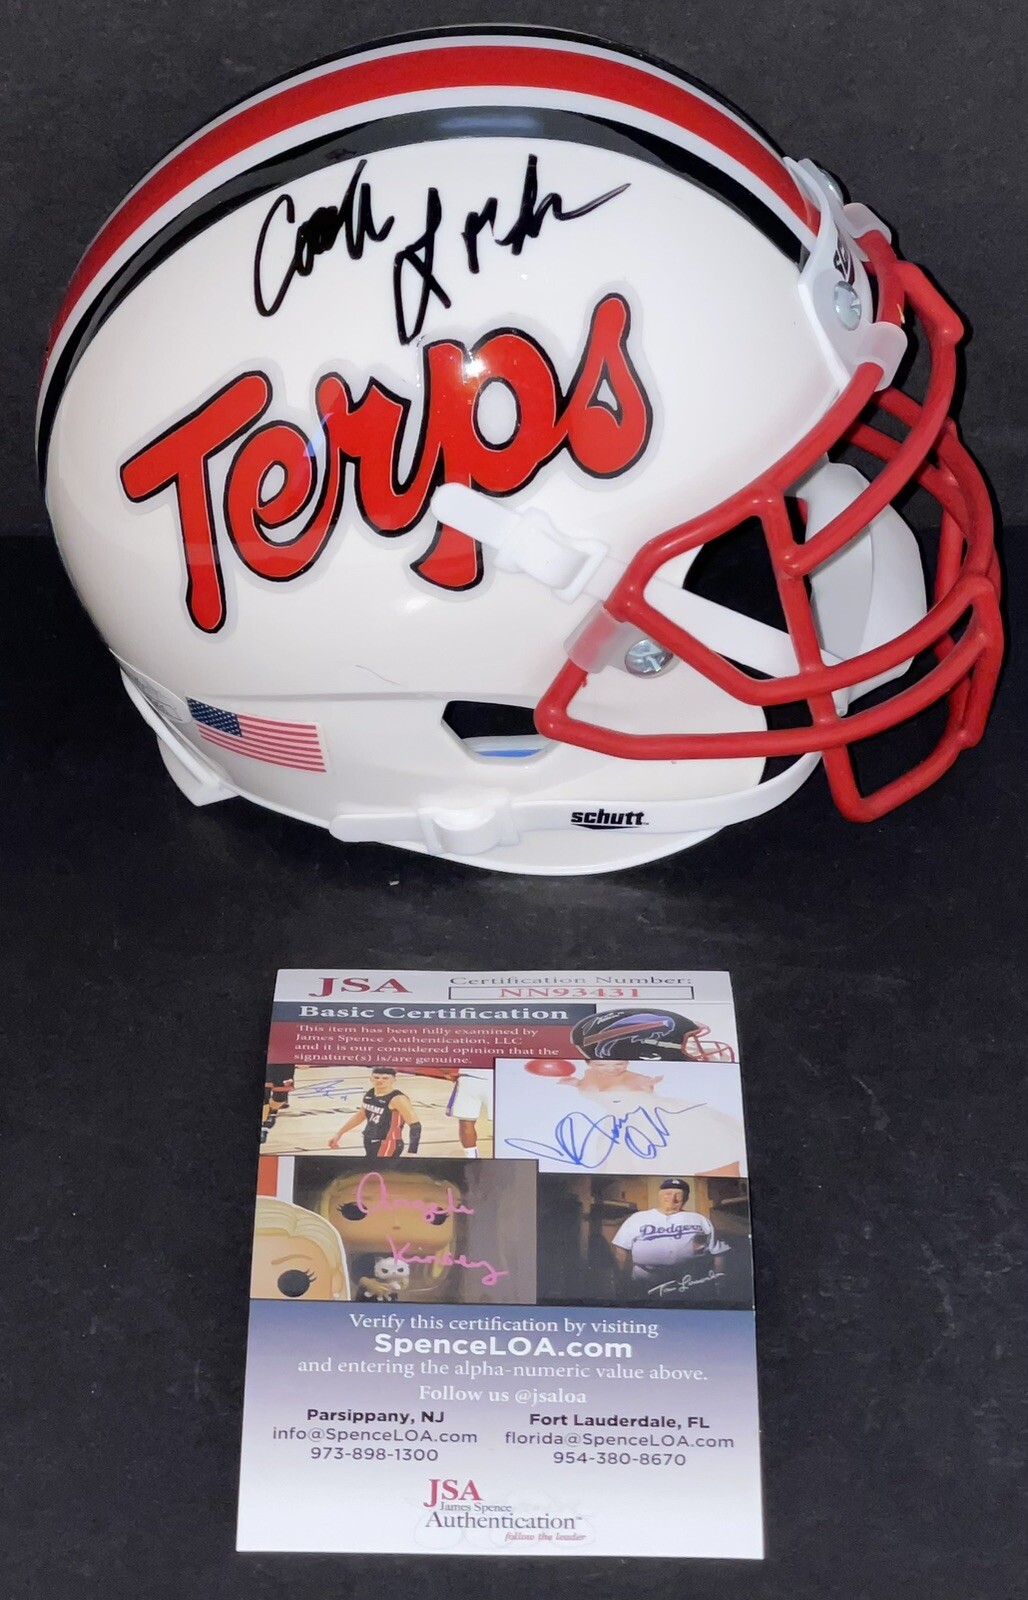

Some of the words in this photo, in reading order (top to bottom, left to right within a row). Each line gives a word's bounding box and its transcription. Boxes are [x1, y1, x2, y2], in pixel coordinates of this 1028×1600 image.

[119, 292, 654, 634] Terps
[571, 809, 644, 825] schutt
[309, 977, 412, 997] JSA
[500, 988, 640, 998] NN93431
[298, 1005, 375, 1018] Basic
[383, 1006, 569, 1020] Certification
[298, 1025, 324, 1033] This
[361, 1026, 383, 1034] has
[386, 1026, 418, 1034] been
[422, 1026, 451, 1036] fully
[454, 1027, 520, 1035] examined
[522, 1028, 539, 1037] by
[295, 1034, 334, 1042] James
[338, 1034, 385, 1044] Spence
[388, 1035, 491, 1045] Authentication,
[494, 1037, 522, 1045] LLC
[323, 1043, 333, 1051] it
[377, 1045, 449, 1053] considered
[453, 1046, 506, 1055] opinion
[509, 1047, 533, 1055] that
[294, 1053, 372, 1062] signature(s)
[376, 1054, 412, 1063] is/are
[416, 1056, 472, 1064] genuine.
[349, 1313, 405, 1332] Verify
[411, 1316, 443, 1329] this
[449, 1318, 558, 1332] certification
[564, 1318, 587, 1336] by
[592, 1320, 659, 1337] visiting
[375, 1334, 633, 1358] SpenceLOA.com
[298, 1358, 332, 1372] and
[338, 1361, 414, 1377] entering
[421, 1360, 449, 1375] the
[454, 1360, 591, 1378] alpha-numeric
[596, 1365, 644, 1379] value
[649, 1365, 707, 1381] above.
[419, 1385, 483, 1401] Follow
[489, 1390, 509, 1402] us
[515, 1388, 587, 1407] @jsaloa
[307, 1409, 415, 1424] Parsippany,
[421, 1411, 445, 1422] NJ
[529, 1414, 567, 1426] Fort
[574, 1415, 682, 1430] Lauderdale,
[688, 1417, 710, 1428] FL
[273, 1427, 478, 1443] info@SpenceLOA.com
[505, 1432, 734, 1447] florida@SpenceLOA.com
[311, 1447, 438, 1461] 973-898-1300
[553, 1452, 686, 1466] 954-380-8670
[423, 1479, 483, 1507] JSA
[439, 1502, 471, 1511] James
[474, 1503, 512, 1513] Spence
[504, 1532, 534, 1542] follow
[538, 1532, 553, 1541] the
[556, 1533, 586, 1541] leader
